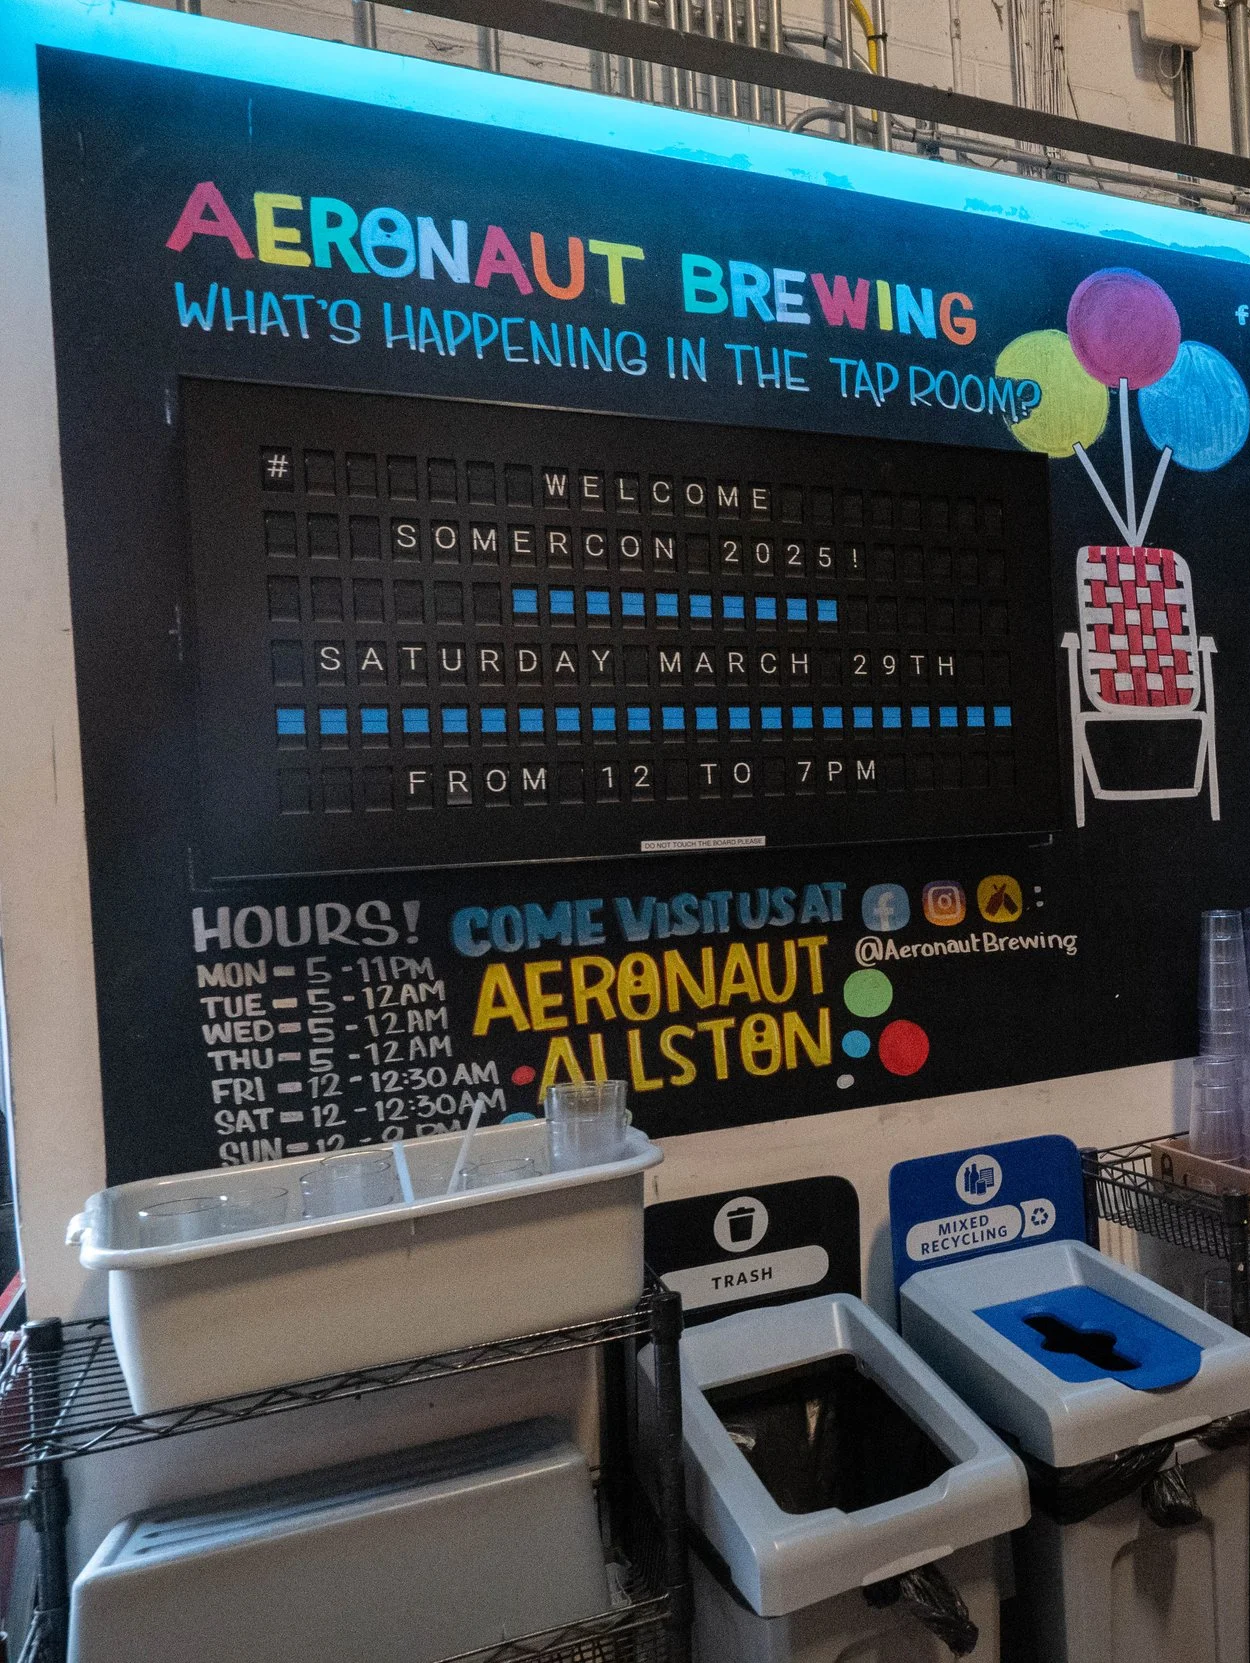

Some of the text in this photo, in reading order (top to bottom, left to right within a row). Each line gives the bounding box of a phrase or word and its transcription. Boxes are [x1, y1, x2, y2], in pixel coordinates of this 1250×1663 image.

[165, 181, 977, 346] AERONAUT BREWING
[175, 282, 1041, 422] WHAT'S HAPPENING IN THE TAP ROOM?
[545, 473, 769, 510] WELCOME
[396, 525, 858, 568] SOMERCON 2025!
[320, 646, 956, 677] SATURDAY MARCH 29TH
[409, 760, 876, 795] FROM 12 TO 7PM
[656, 841, 671, 849] NOT
[673, 840, 696, 848] TOUCH
[192, 899, 421, 953] HOURS!
[451, 882, 847, 958] COME VISIT US AT
[196, 959, 267, 988] MON
[472, 936, 829, 1036] AERONAUT
[200, 993, 266, 1019] TUE
[202, 1020, 274, 1045] WED
[207, 1048, 273, 1071] THU
[537, 1007, 833, 1105] ALLSTON
[211, 1077, 266, 1104] FRI
[215, 1108, 274, 1135] SAT
[218, 1138, 282, 1168] SUN
[938, 1213, 990, 1237] MIXED
[920, 1225, 1008, 1257] RECYCLING
[711, 1266, 774, 1290] TRASH
